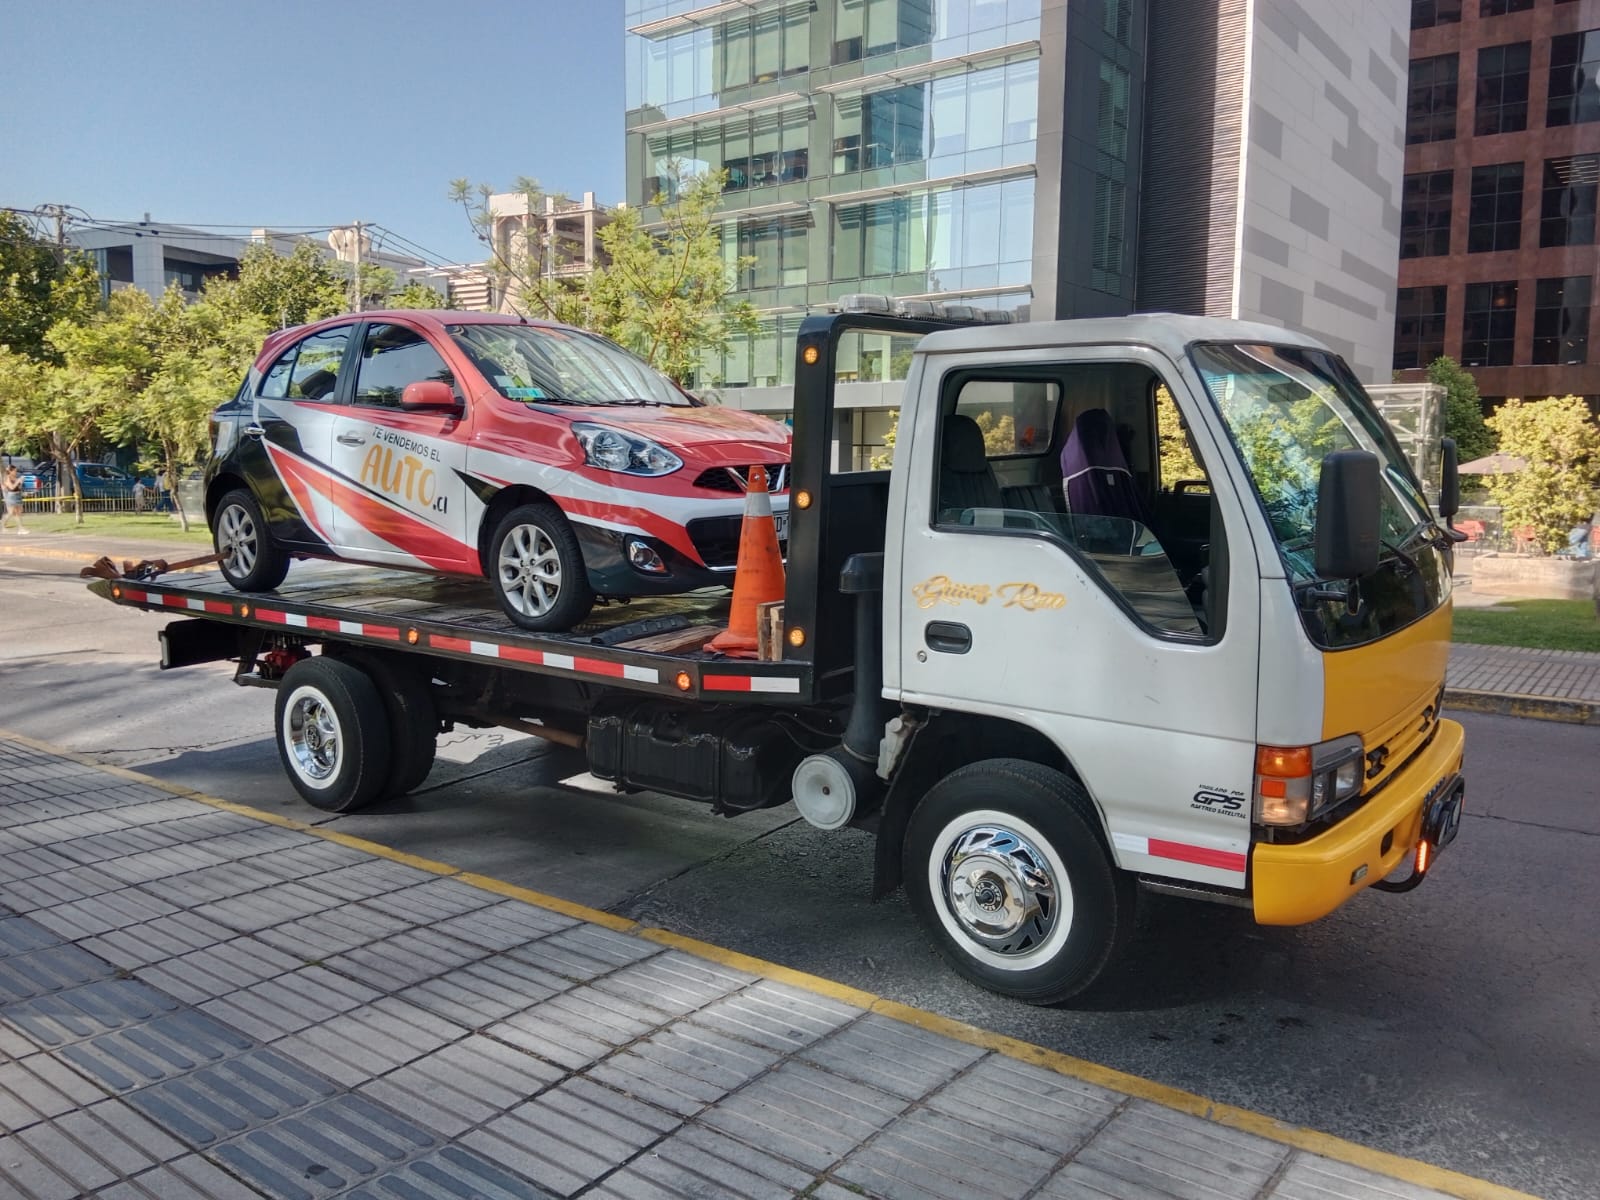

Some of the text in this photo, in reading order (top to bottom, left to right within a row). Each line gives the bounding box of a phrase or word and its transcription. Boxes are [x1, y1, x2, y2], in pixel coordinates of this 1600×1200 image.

[372, 427, 441, 463] TE VENDEMOS EL
[1193, 790, 1246, 811] GPS
